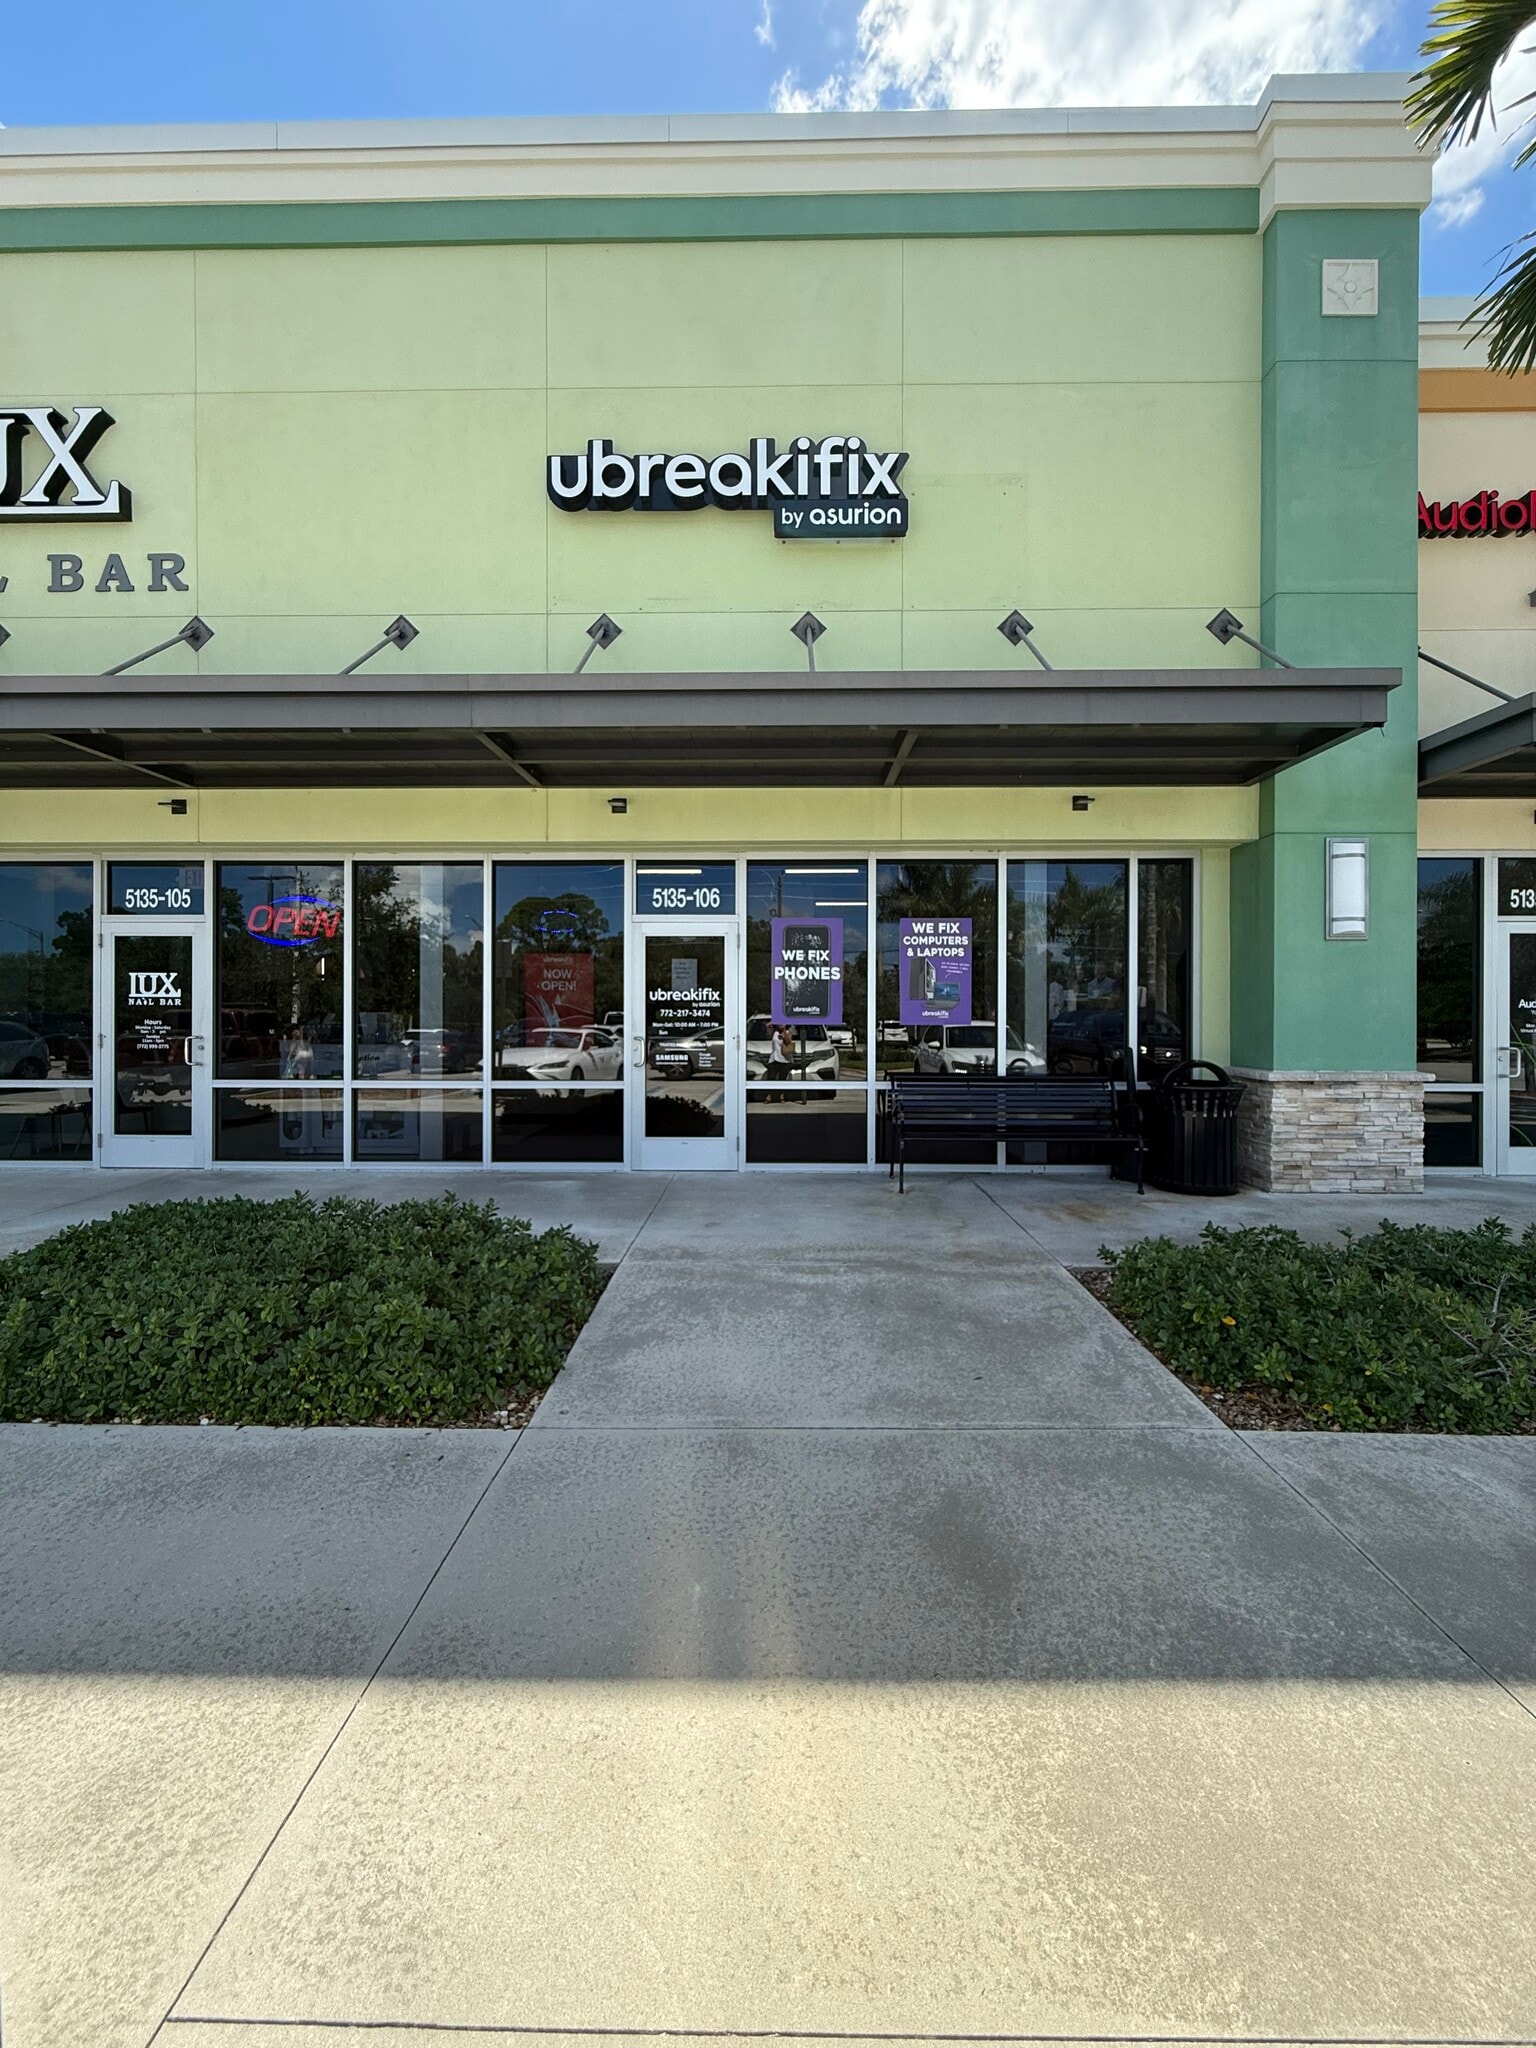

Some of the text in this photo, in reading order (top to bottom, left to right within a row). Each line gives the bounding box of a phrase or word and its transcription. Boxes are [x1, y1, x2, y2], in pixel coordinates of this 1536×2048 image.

[551, 437, 901, 500] ubreakifix
[781, 502, 902, 528] by asurion
[47, 553, 190, 592] BAR
[125, 888, 191, 908] 5135-105
[652, 888, 720, 908] 5135-106
[247, 904, 342, 938] OPEN
[912, 922, 960, 934] WE FIX
[903, 936, 969, 945] COMPUTERS
[781, 949, 830, 961] WE FIX
[907, 947, 965, 957] & LAPTOPS
[543, 969, 572, 979] NOW
[774, 966, 841, 980] PHONES
[128, 972, 182, 998] LUX
[541, 981, 577, 991] OPEN!
[649, 987, 720, 1001] ubreakifix
[159, 998, 182, 1006] BAR
[660, 1009, 711, 1017] 772-217-3474
